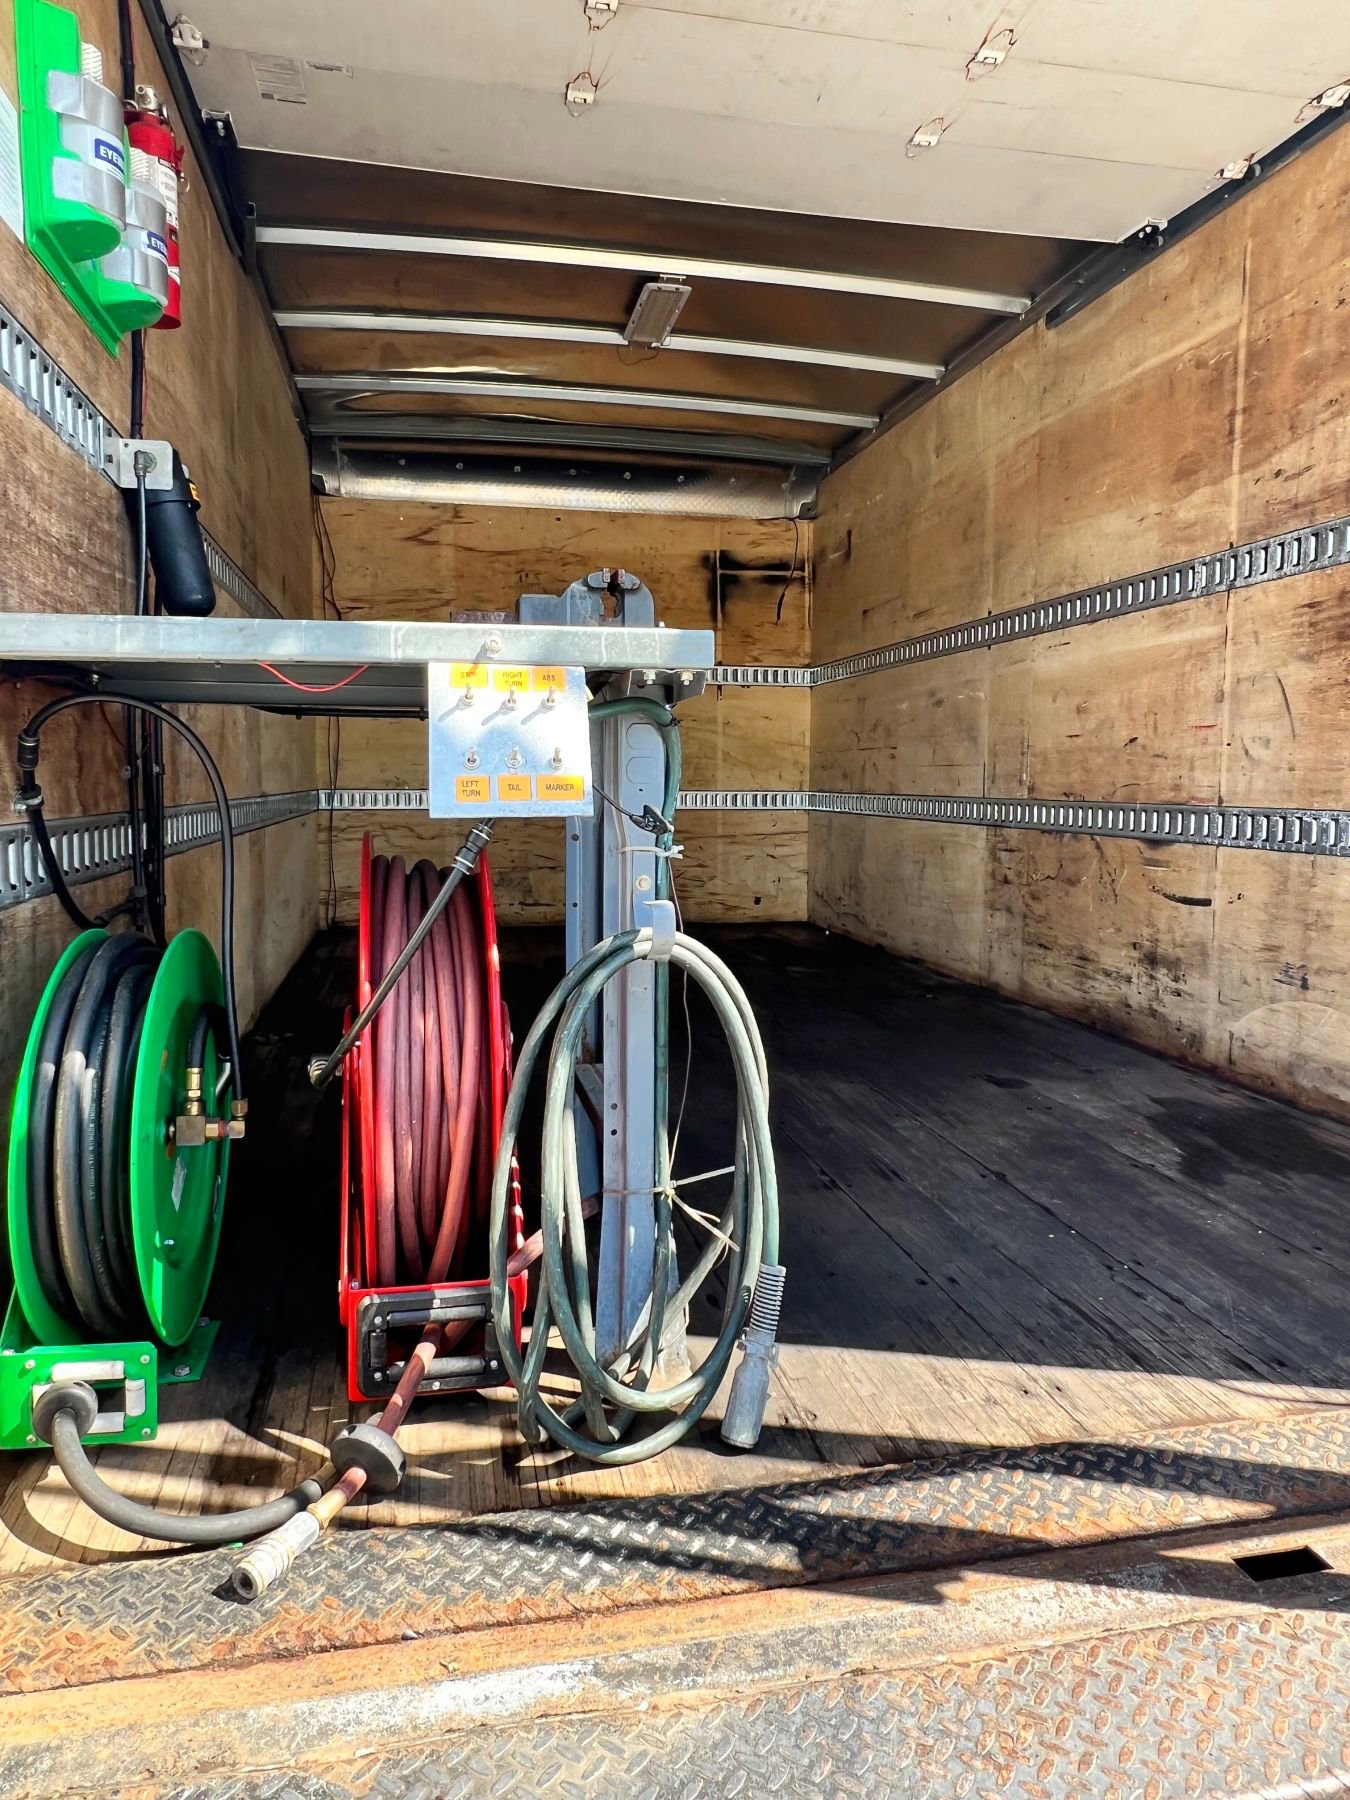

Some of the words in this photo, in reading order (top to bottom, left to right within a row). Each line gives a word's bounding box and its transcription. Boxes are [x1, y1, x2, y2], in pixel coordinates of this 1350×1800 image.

[542, 674, 556, 682] ABS
[461, 780, 479, 788] LEFT
[507, 784, 522, 792] TAIL
[545, 784, 575, 792] MARKER
[461, 789, 481, 797] TURN
